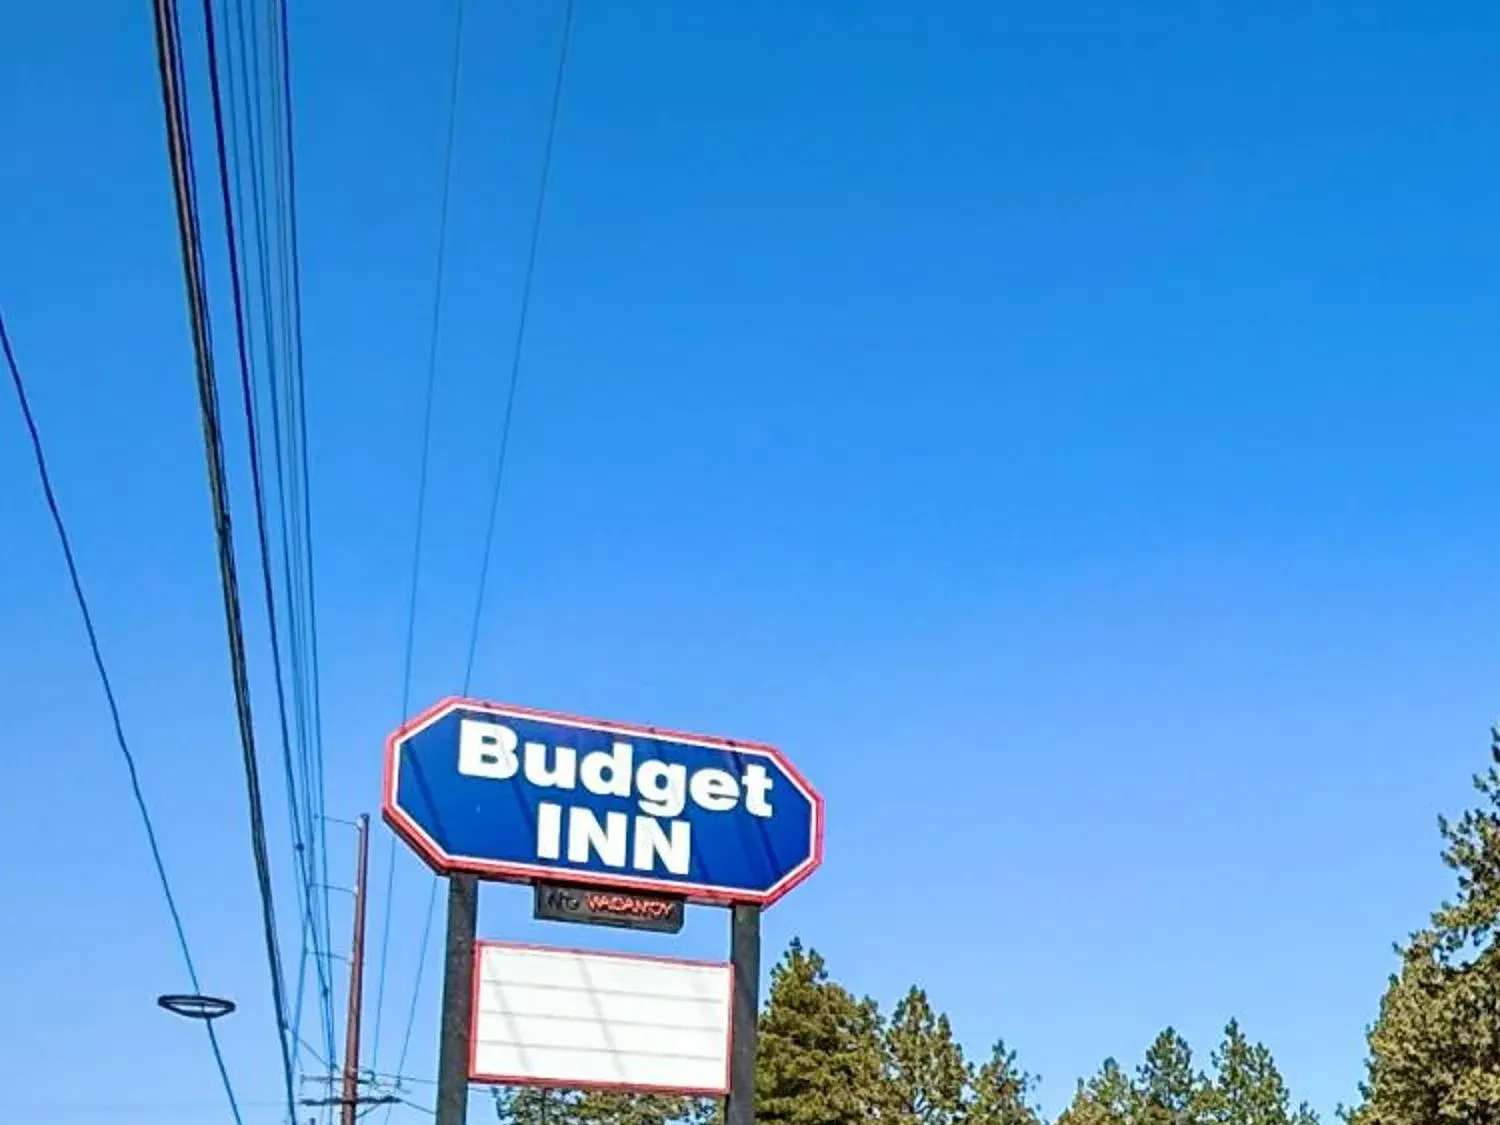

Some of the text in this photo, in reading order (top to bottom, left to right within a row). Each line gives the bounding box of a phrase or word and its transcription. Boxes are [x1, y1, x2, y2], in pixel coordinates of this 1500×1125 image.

[456, 719, 774, 817] Budget
[537, 802, 692, 875] INN
[586, 893, 673, 917] VACANCY
